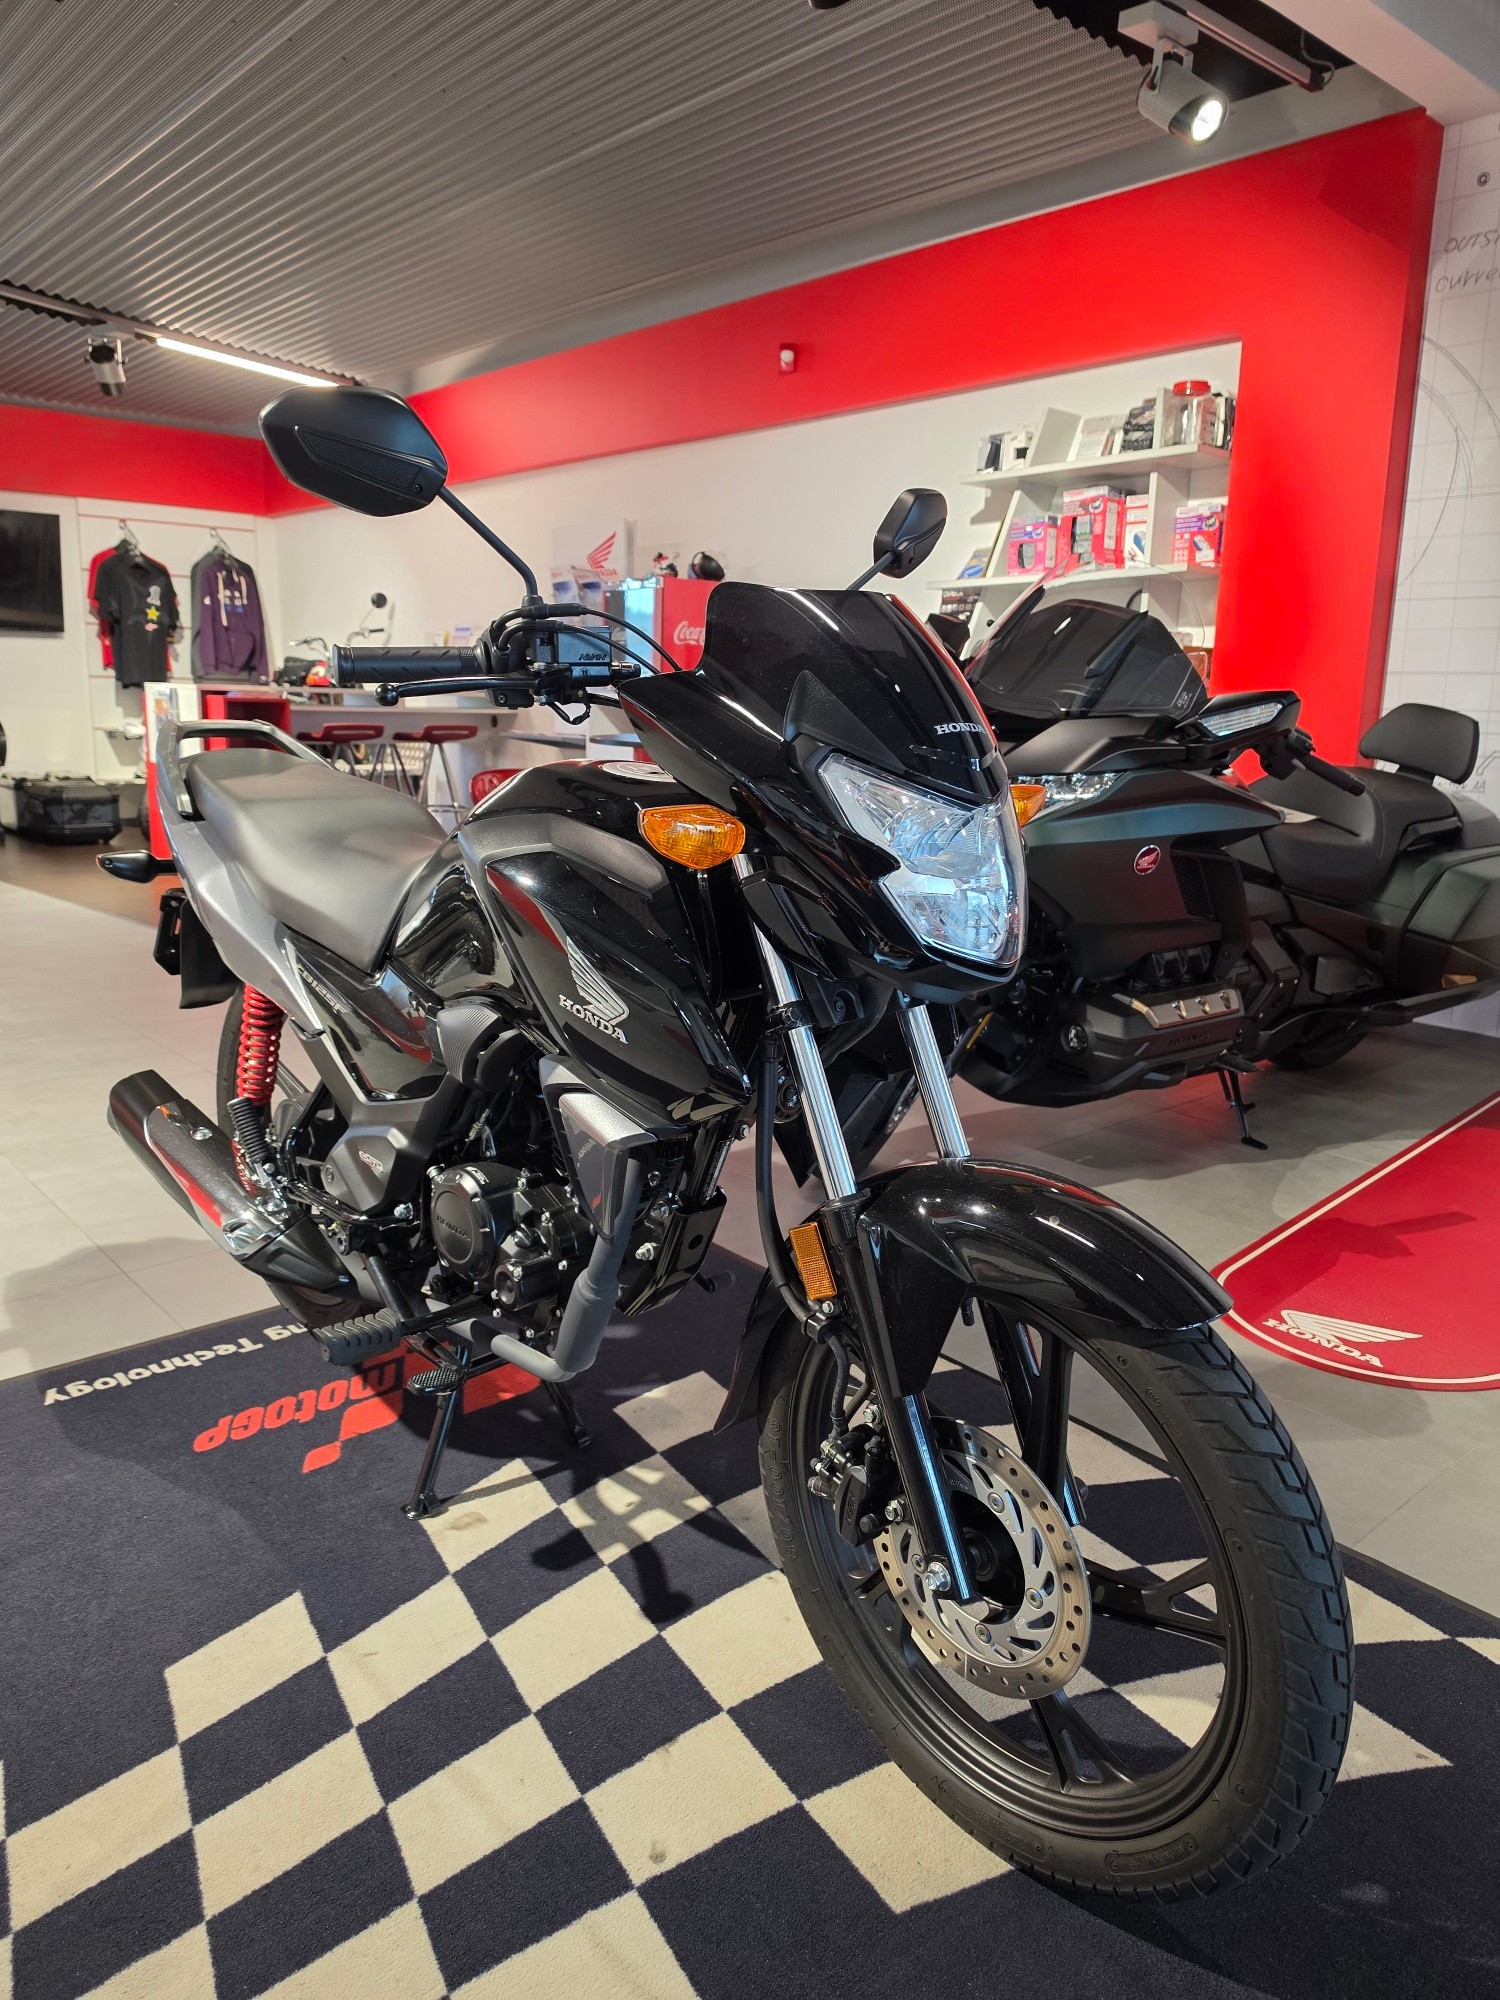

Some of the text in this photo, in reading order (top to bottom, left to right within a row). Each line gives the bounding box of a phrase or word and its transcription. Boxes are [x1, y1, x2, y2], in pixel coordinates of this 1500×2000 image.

[934, 722, 986, 735] HONDA
[559, 994, 629, 1044] HONDA
[1262, 1318, 1384, 1368] HONDA
[44, 1337, 264, 1406] Technology
